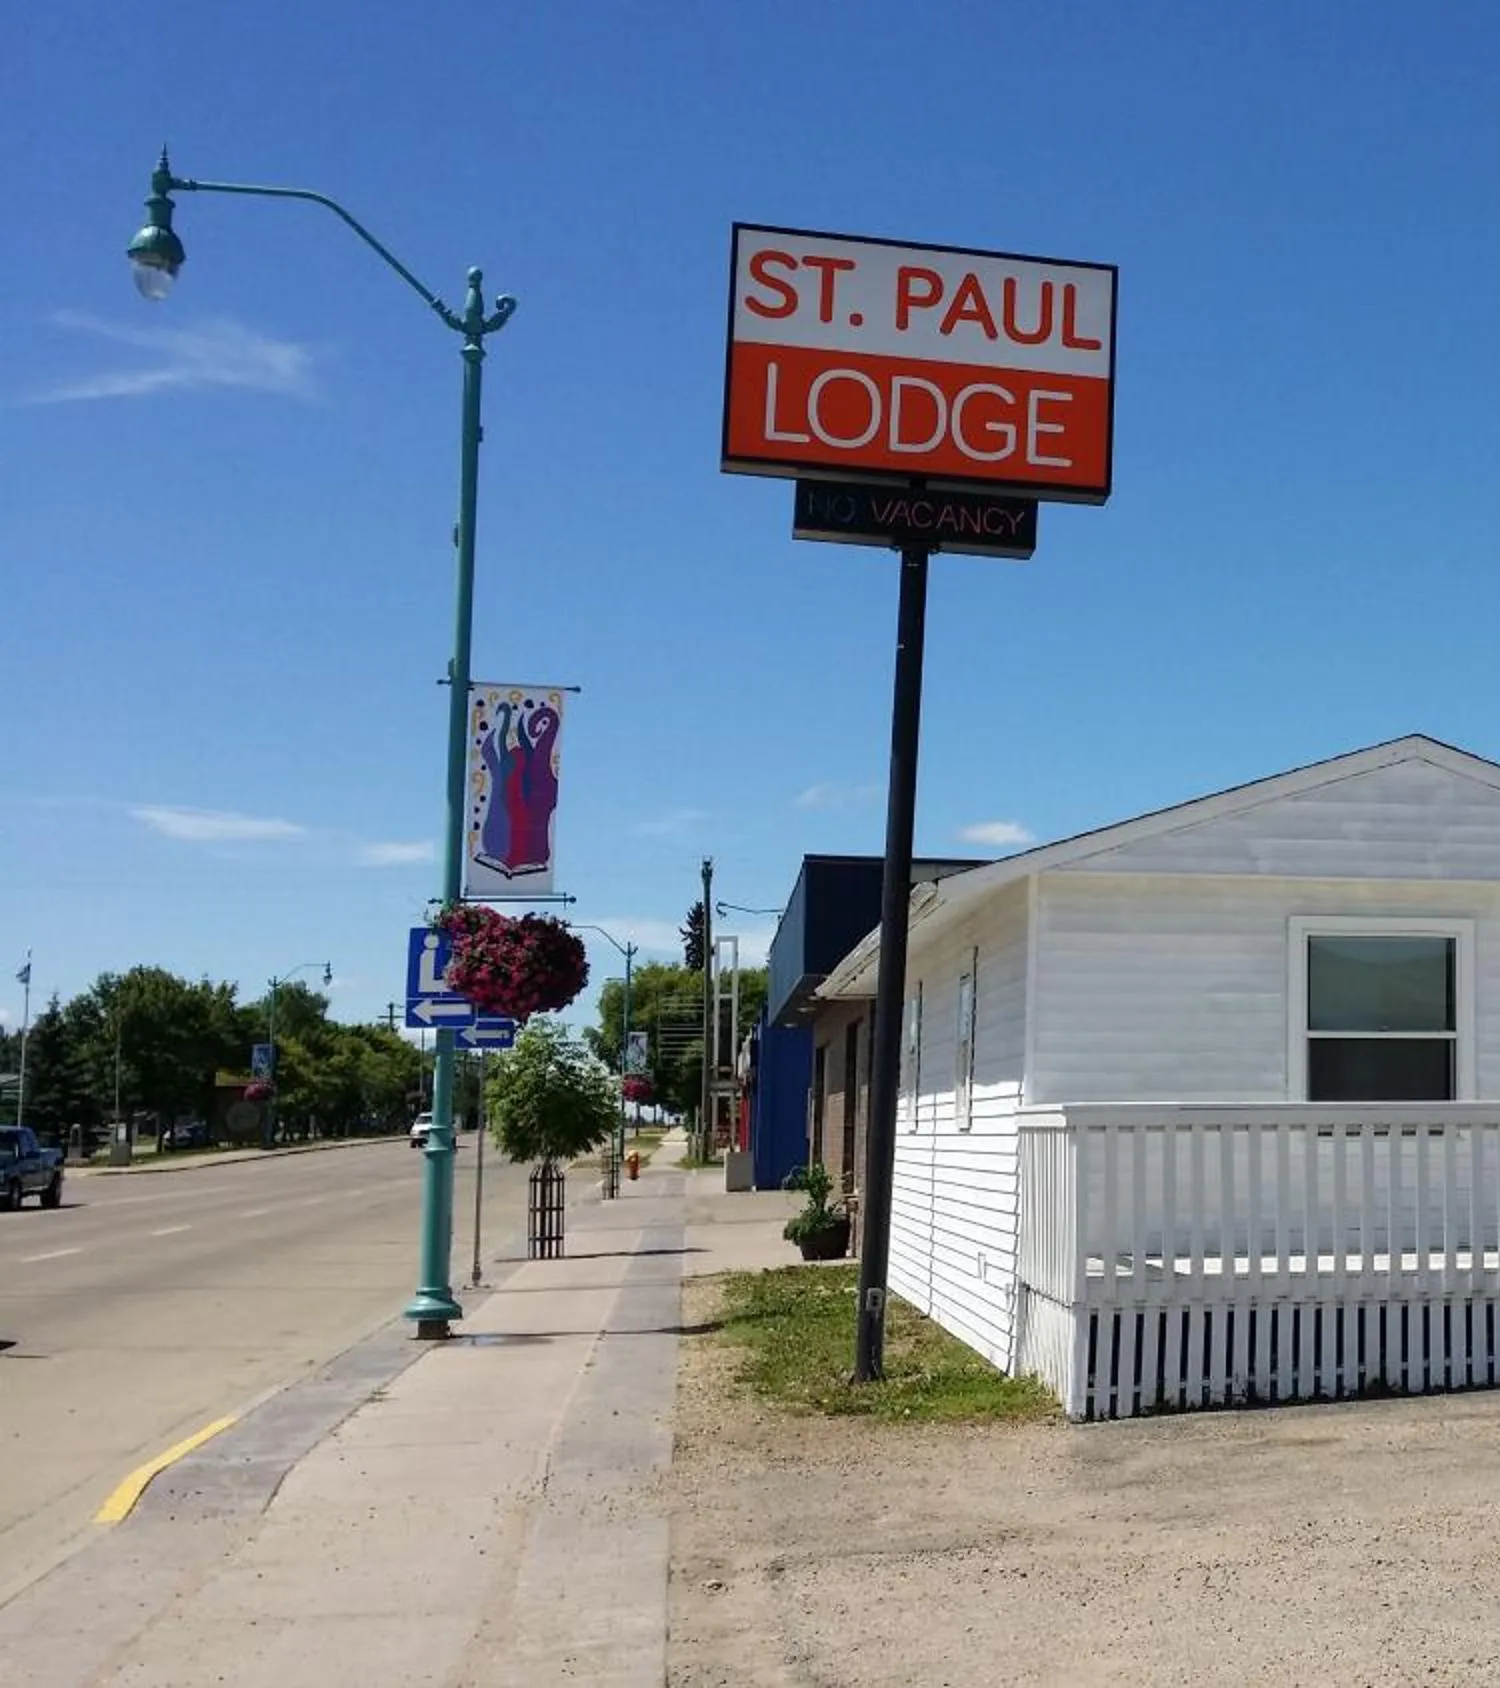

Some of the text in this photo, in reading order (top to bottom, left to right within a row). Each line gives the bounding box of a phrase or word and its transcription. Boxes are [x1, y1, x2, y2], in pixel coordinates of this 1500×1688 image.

[745, 249, 1103, 351] ST. PAUL
[764, 361, 1074, 468] LODGE
[806, 490, 1025, 537] NO VACANCY
